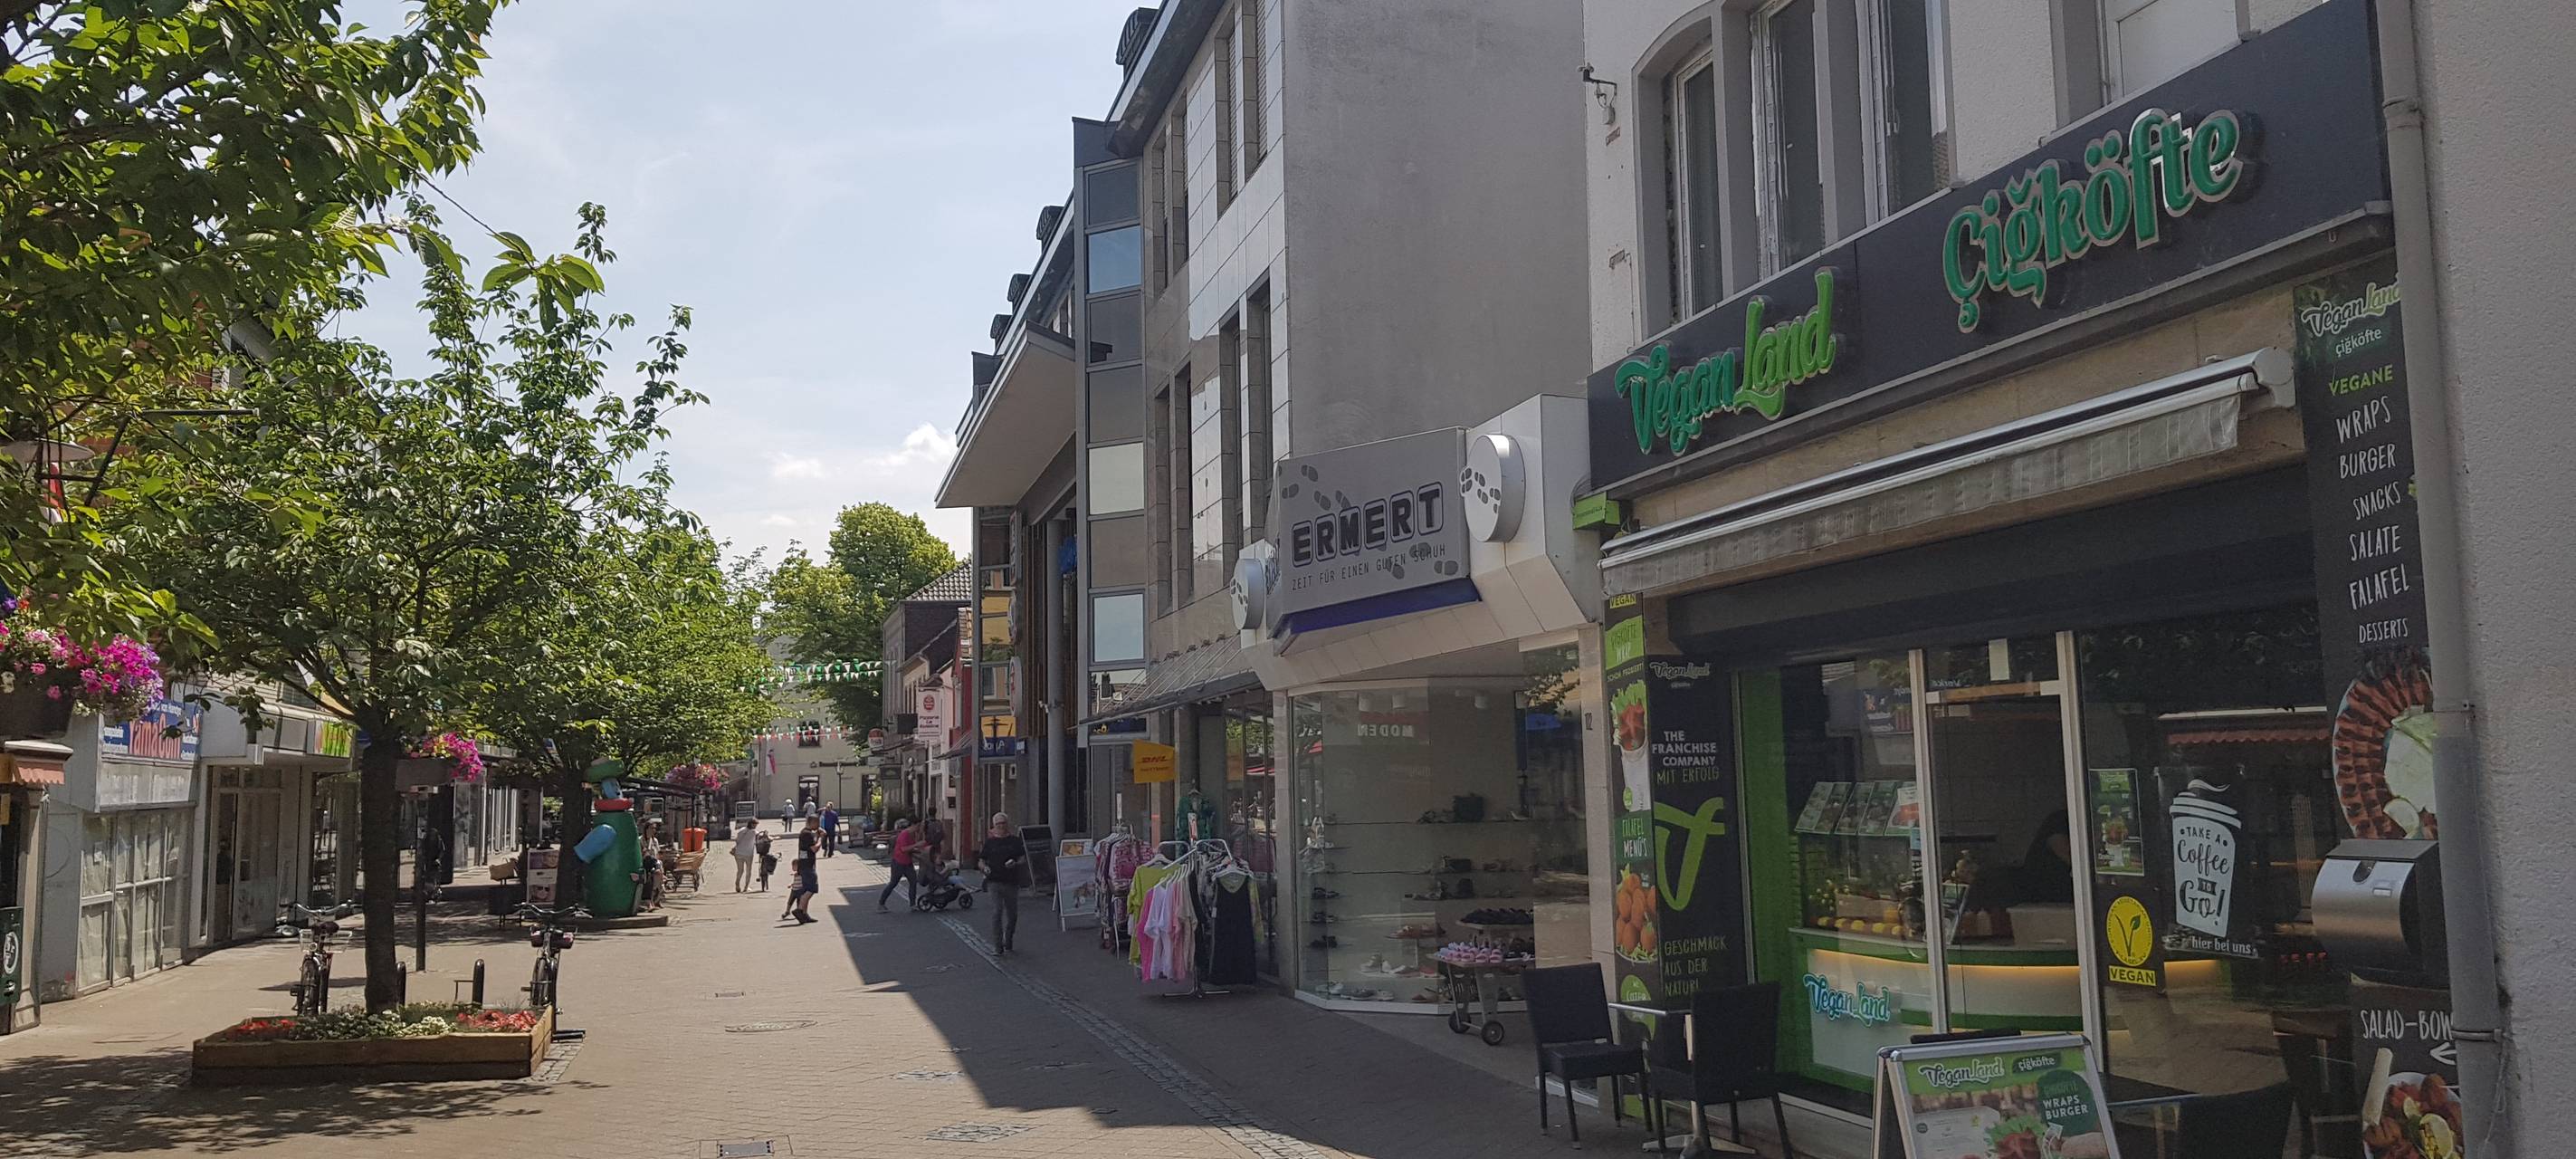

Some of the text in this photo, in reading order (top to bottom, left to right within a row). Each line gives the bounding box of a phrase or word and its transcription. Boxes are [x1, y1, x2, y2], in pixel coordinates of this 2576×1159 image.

[1943, 109, 2244, 332] Çiğköfte
[2329, 364, 2394, 396] VEGANE
[2336, 396, 2391, 444] WRAPS
[2340, 443, 2396, 479] BURGER
[2353, 481, 2401, 521] SNACKS
[1292, 482, 1444, 568] ERMERT
[2349, 525, 2401, 561] SALATE
[1292, 544, 1445, 590] ZEIT FÜR EINEN GUTEN SCHUH
[2349, 563, 2409, 610] FALAFEL
[1610, 594, 1636, 608] VEGAN
[2359, 618, 2409, 644] DESSERTS
[1664, 730, 1685, 742] THE
[1652, 742, 1717, 753] FRANCHISE
[1663, 756, 1716, 766] COMPANY
[1656, 766, 1720, 784] MIT ERFOLG
[2186, 827, 2221, 844] TAKE A
[2178, 839, 2230, 876] Coffee
[2201, 882, 2212, 892] TO
[2180, 880, 2226, 926] Go!
[1664, 934, 1729, 956] GESCHMACK
[2191, 934, 2212, 949] hier
[2214, 938, 2230, 952] bei
[1665, 957, 1709, 976] AUS DER
[2110, 967, 2155, 984] VEGAN
[2043, 1094, 2081, 1110] WRAPS
[2046, 1104, 2089, 1121] BURGER
